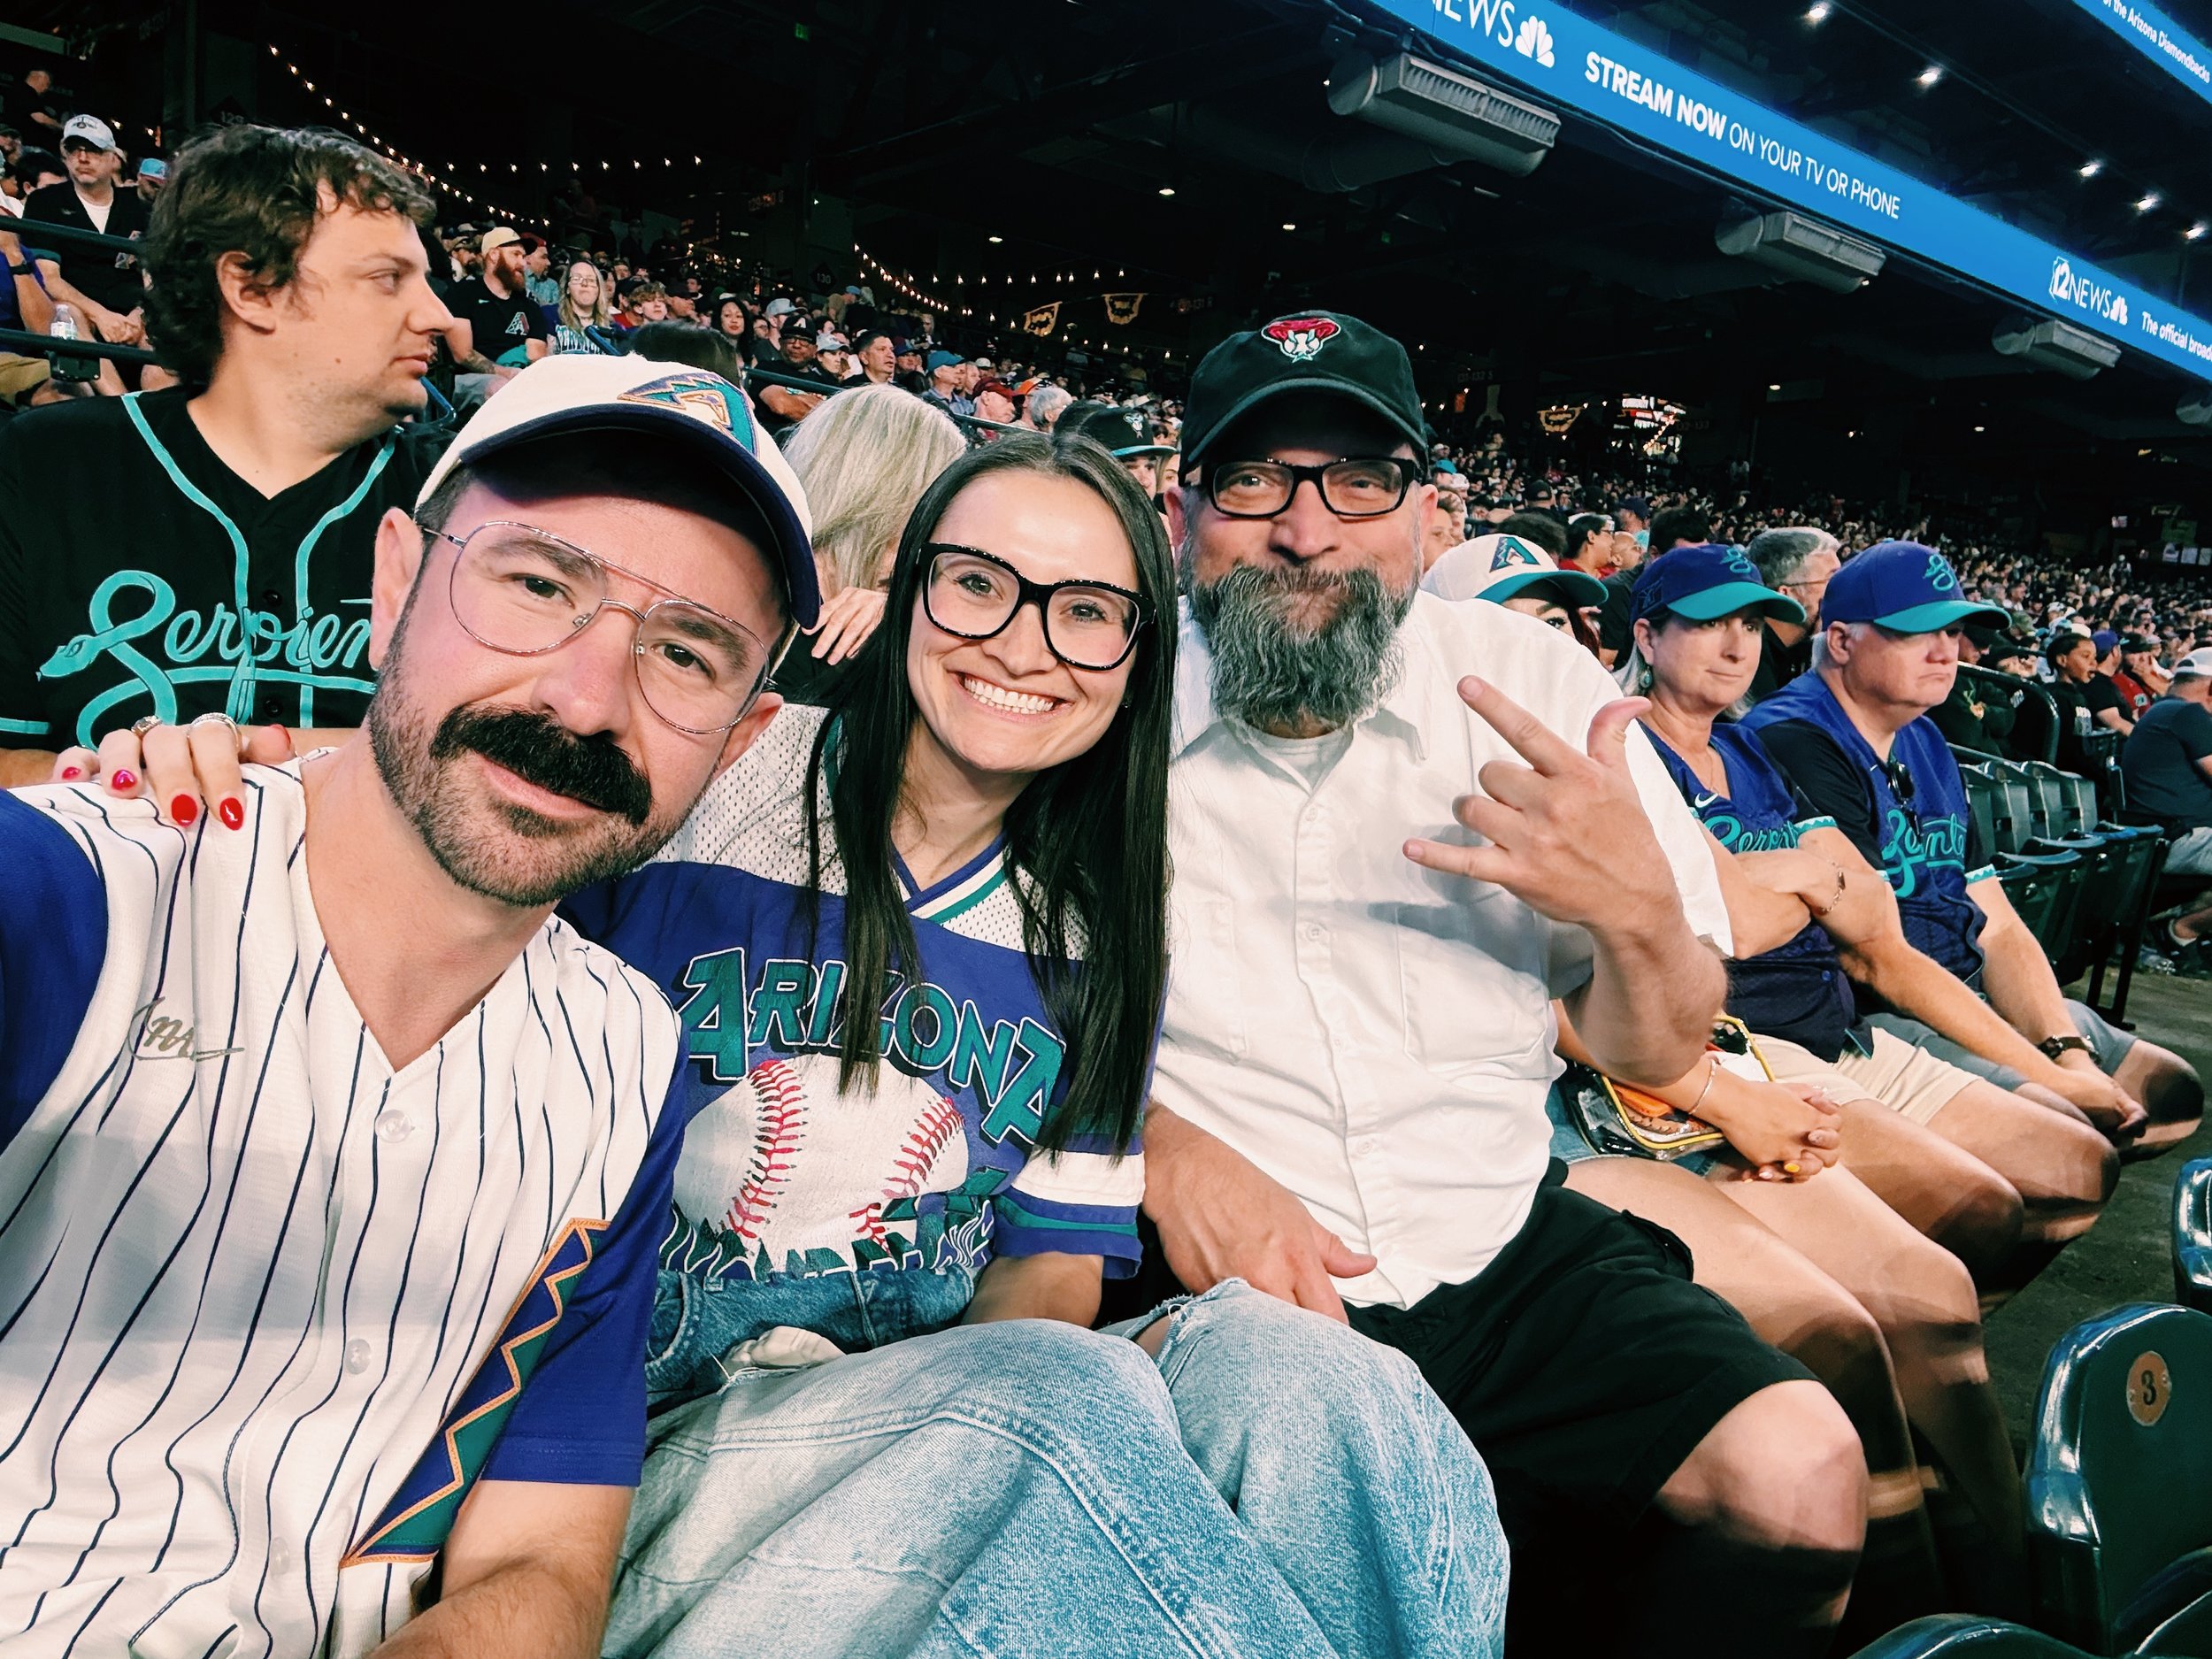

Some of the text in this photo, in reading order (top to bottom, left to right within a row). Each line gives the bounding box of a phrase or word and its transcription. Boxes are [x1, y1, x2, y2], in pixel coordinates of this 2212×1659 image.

[2127, 8, 2157, 42] Arizona
[2158, 30, 2210, 83] Diamondbacks
[1432, 0, 1901, 219] WS STREAM NOW ON YOUR TV OR PHONE
[2142, 311, 2158, 336] The
[2160, 323, 2188, 349] official
[2141, 1369, 2157, 1406] 3
